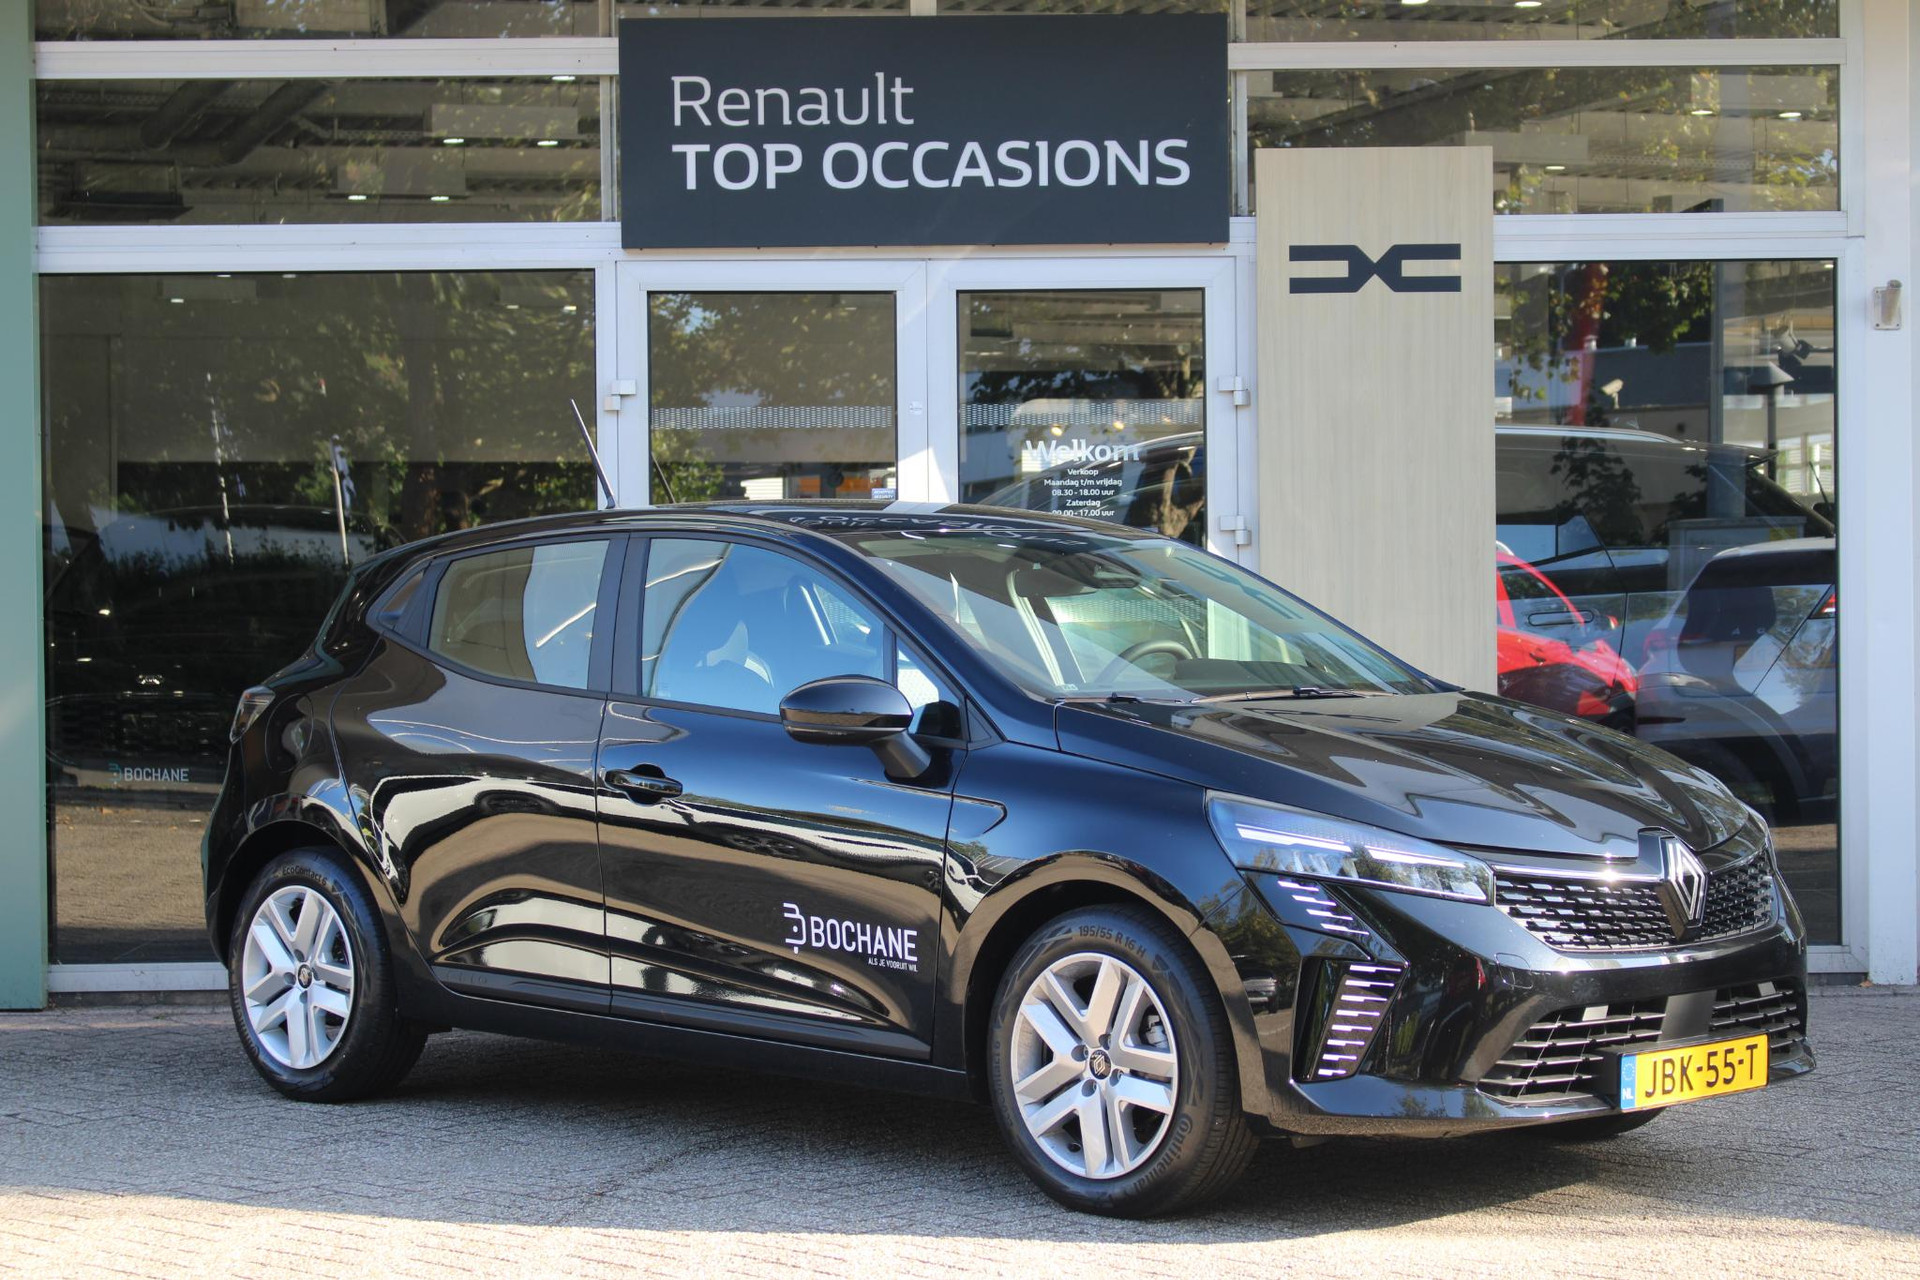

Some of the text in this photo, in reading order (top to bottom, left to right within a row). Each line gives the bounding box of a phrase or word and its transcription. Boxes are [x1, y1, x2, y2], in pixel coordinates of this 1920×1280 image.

[671, 72, 914, 127] Renault
[672, 139, 1191, 190] TOP OCCASIONS
[1025, 438, 1140, 462] Welkom
[1044, 479, 1079, 487] Maandag
[1096, 478, 1123, 486] vrijdag
[1067, 468, 1099, 476] Verkoop
[1080, 509, 1100, 517] 17.00
[124, 767, 190, 782] BOCHANE
[810, 916, 918, 962] BOCHANE
[1078, 925, 1113, 940] 195/55
[1115, 931, 1124, 945] R
[1125, 936, 1137, 951] 16
[868, 957, 878, 966] ALS
[1622, 1043, 1758, 1100] NL JBK-55-T
